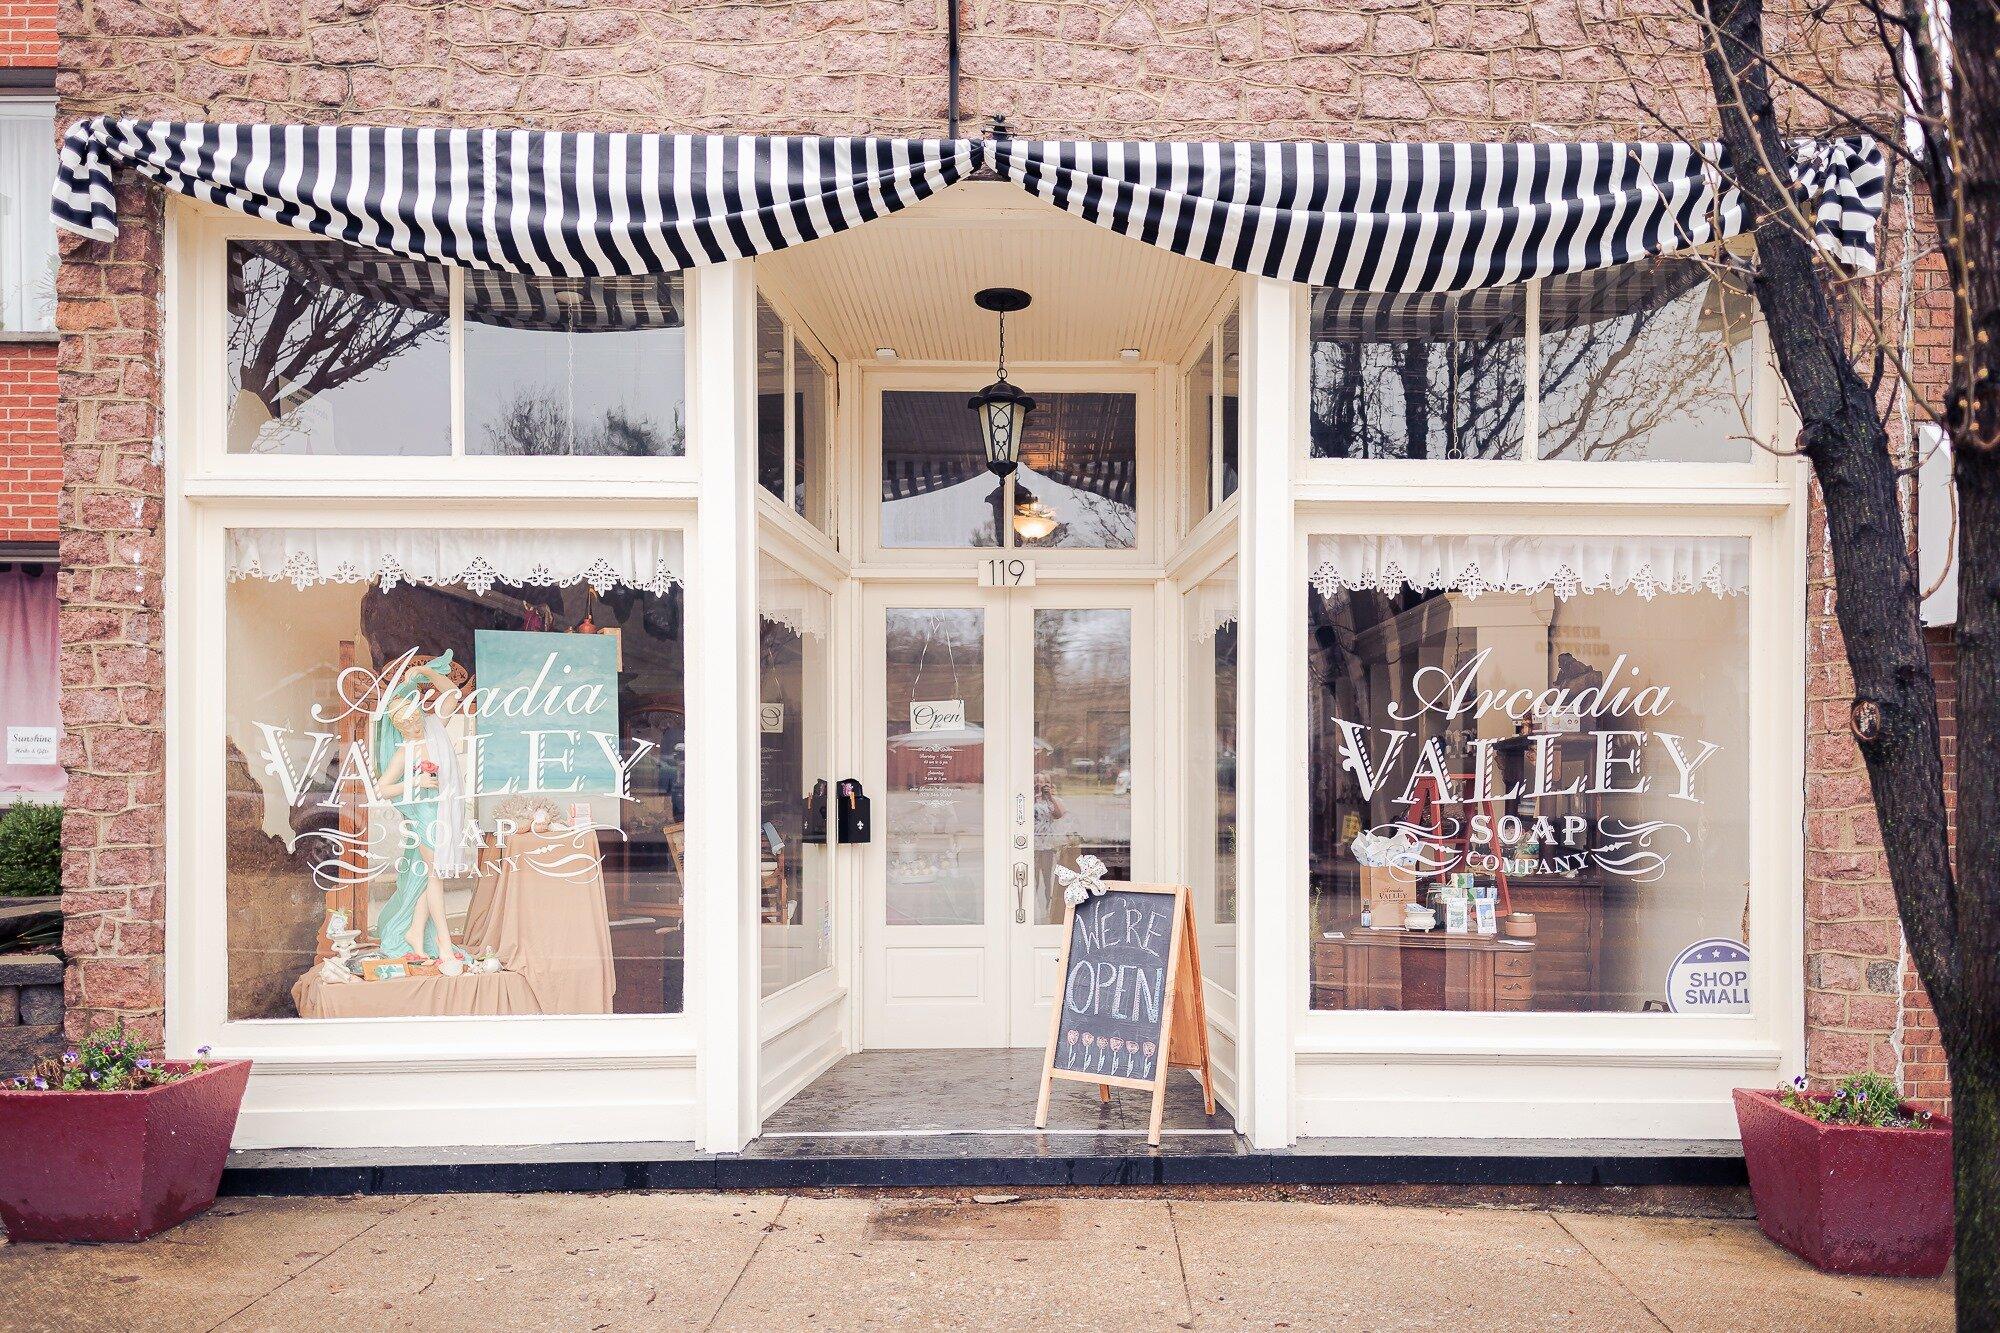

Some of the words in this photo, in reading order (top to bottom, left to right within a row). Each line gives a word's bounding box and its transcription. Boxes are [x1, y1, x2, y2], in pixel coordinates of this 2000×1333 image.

[988, 559, 1025, 586] 119
[311, 645, 608, 723] Arcadia
[1387, 646, 1677, 722] Arcadia
[913, 705, 962, 730] Open
[13, 733, 52, 743] Sunshine
[252, 719, 661, 809] VALLEY
[1330, 716, 1725, 805] VALLEY
[398, 818, 518, 850] SOAP
[1470, 815, 1588, 846] SOAP
[394, 853, 521, 880] COMPANY
[1465, 849, 1591, 876] COMPANY
[1076, 898, 1167, 957] WE'RE
[1065, 959, 1163, 1023] OPEN
[1689, 970, 1747, 988] SHOP
